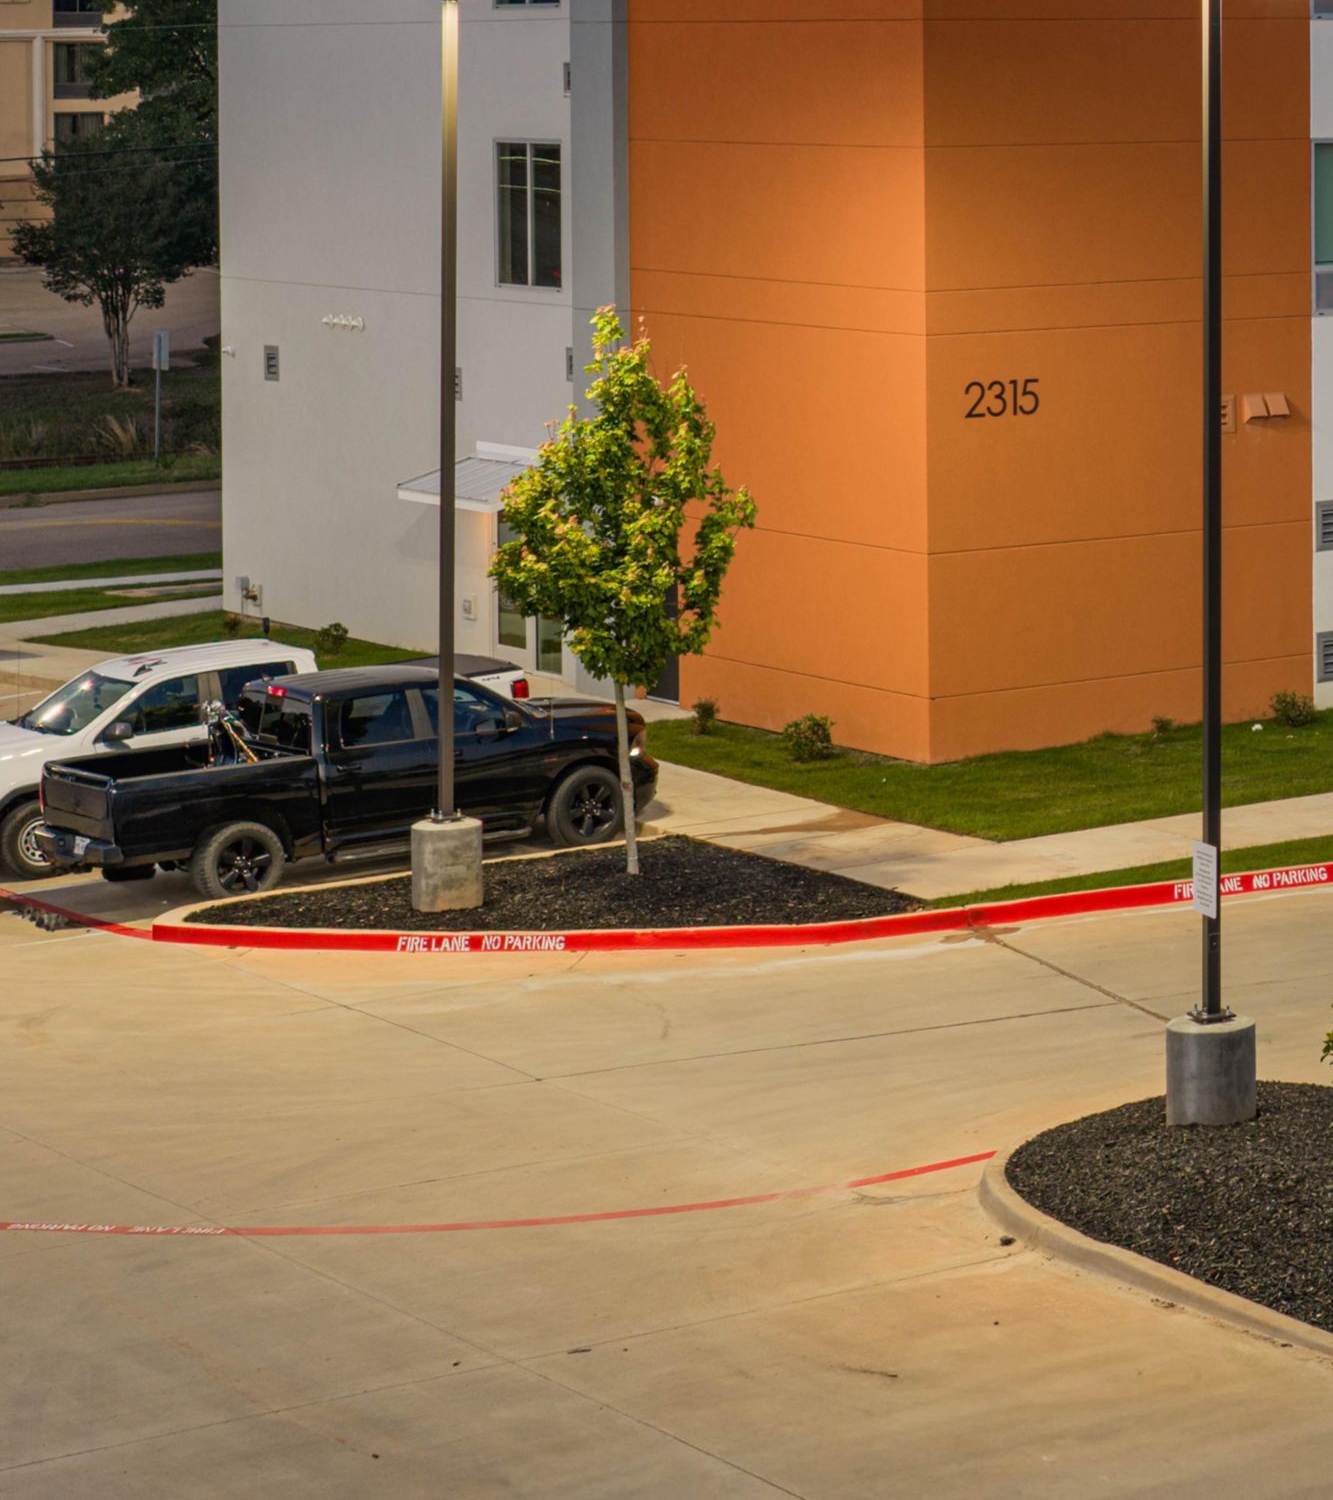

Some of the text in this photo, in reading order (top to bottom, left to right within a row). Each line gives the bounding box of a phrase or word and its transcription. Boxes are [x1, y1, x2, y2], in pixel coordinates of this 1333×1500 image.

[964, 378, 1040, 419] 2315
[1173, 883, 1194, 900] FIR
[1252, 873, 1270, 889] NO
[1272, 867, 1328, 886] PARKING
[396, 934, 566, 952] FIRE LANE NO PARKING
[7, 1223, 88, 1231] PARKING
